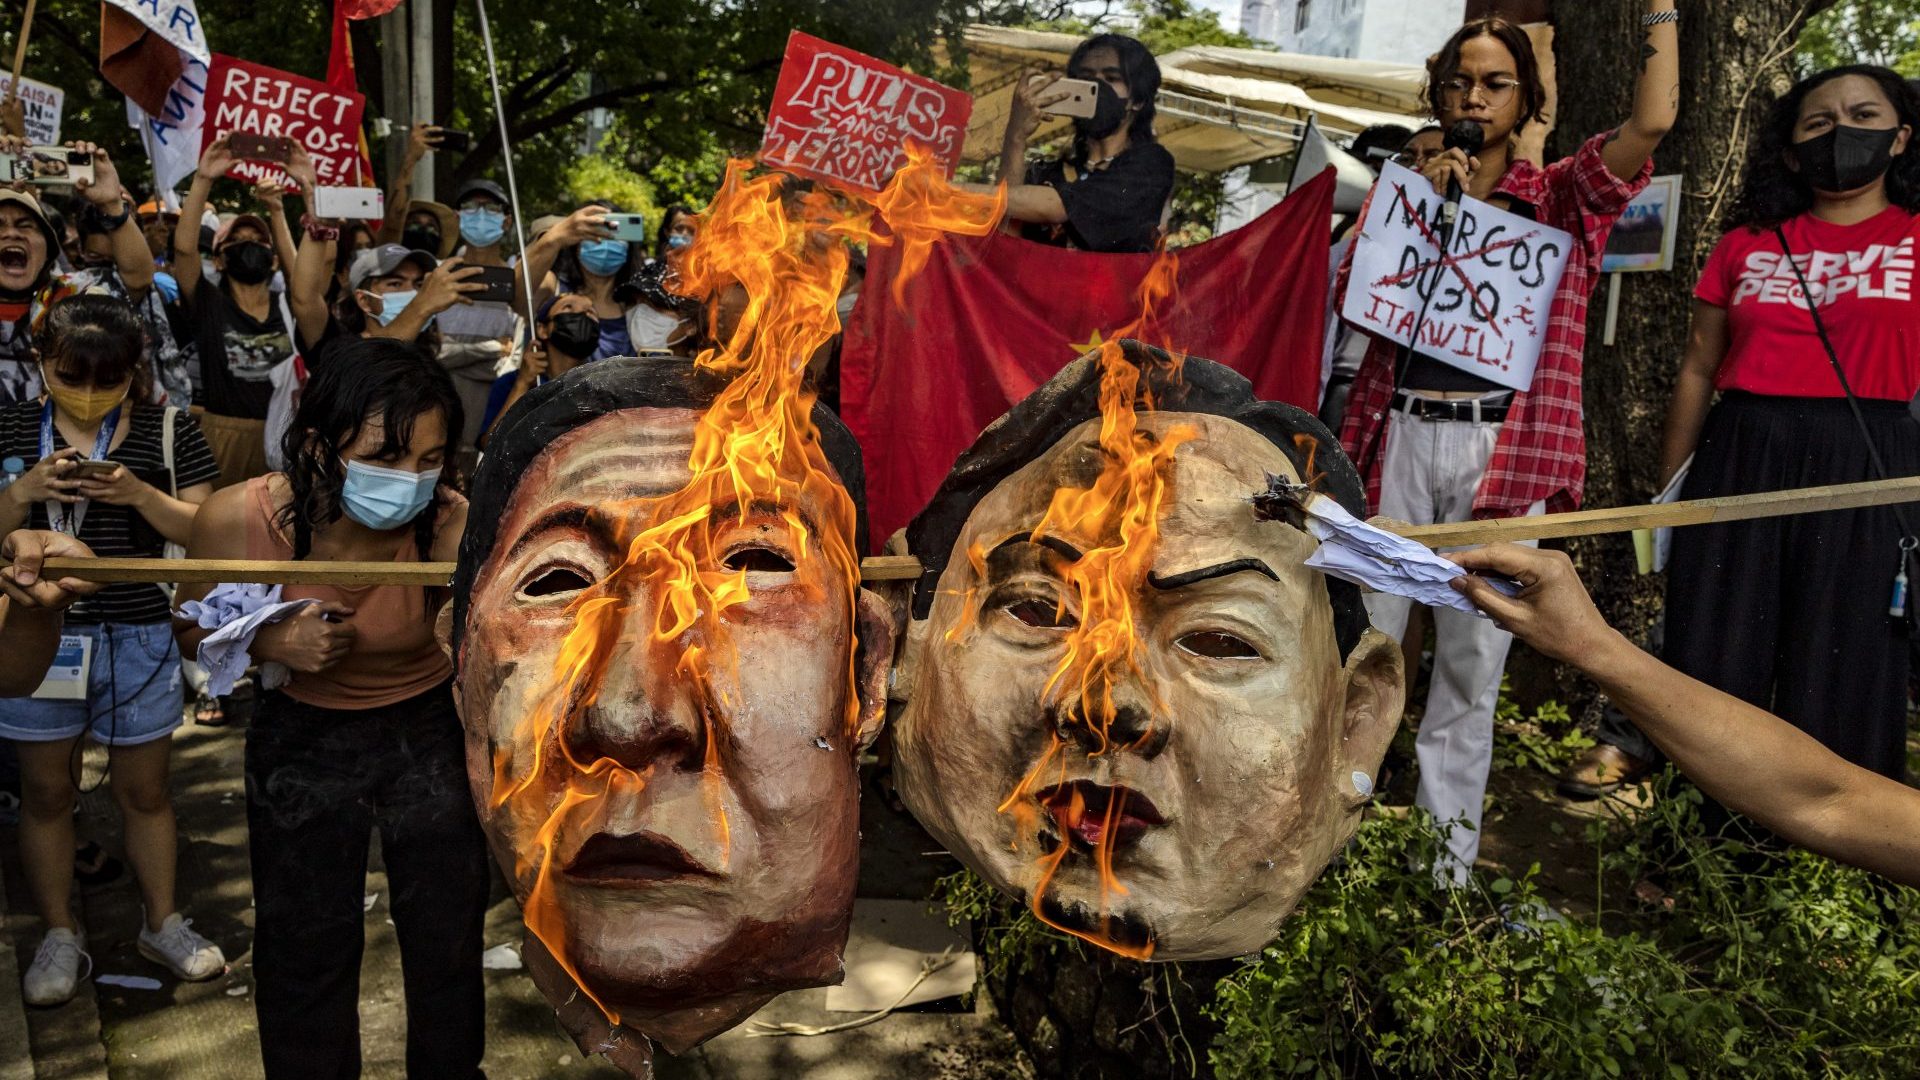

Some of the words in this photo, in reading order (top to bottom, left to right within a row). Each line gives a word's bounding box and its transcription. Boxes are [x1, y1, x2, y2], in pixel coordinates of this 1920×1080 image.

[223, 68, 354, 126] REJECT
[1740, 237, 1915, 281] SERVE
[1733, 270, 1912, 310] PEOPLE
[1364, 293, 1515, 371] ITAKWIL!
